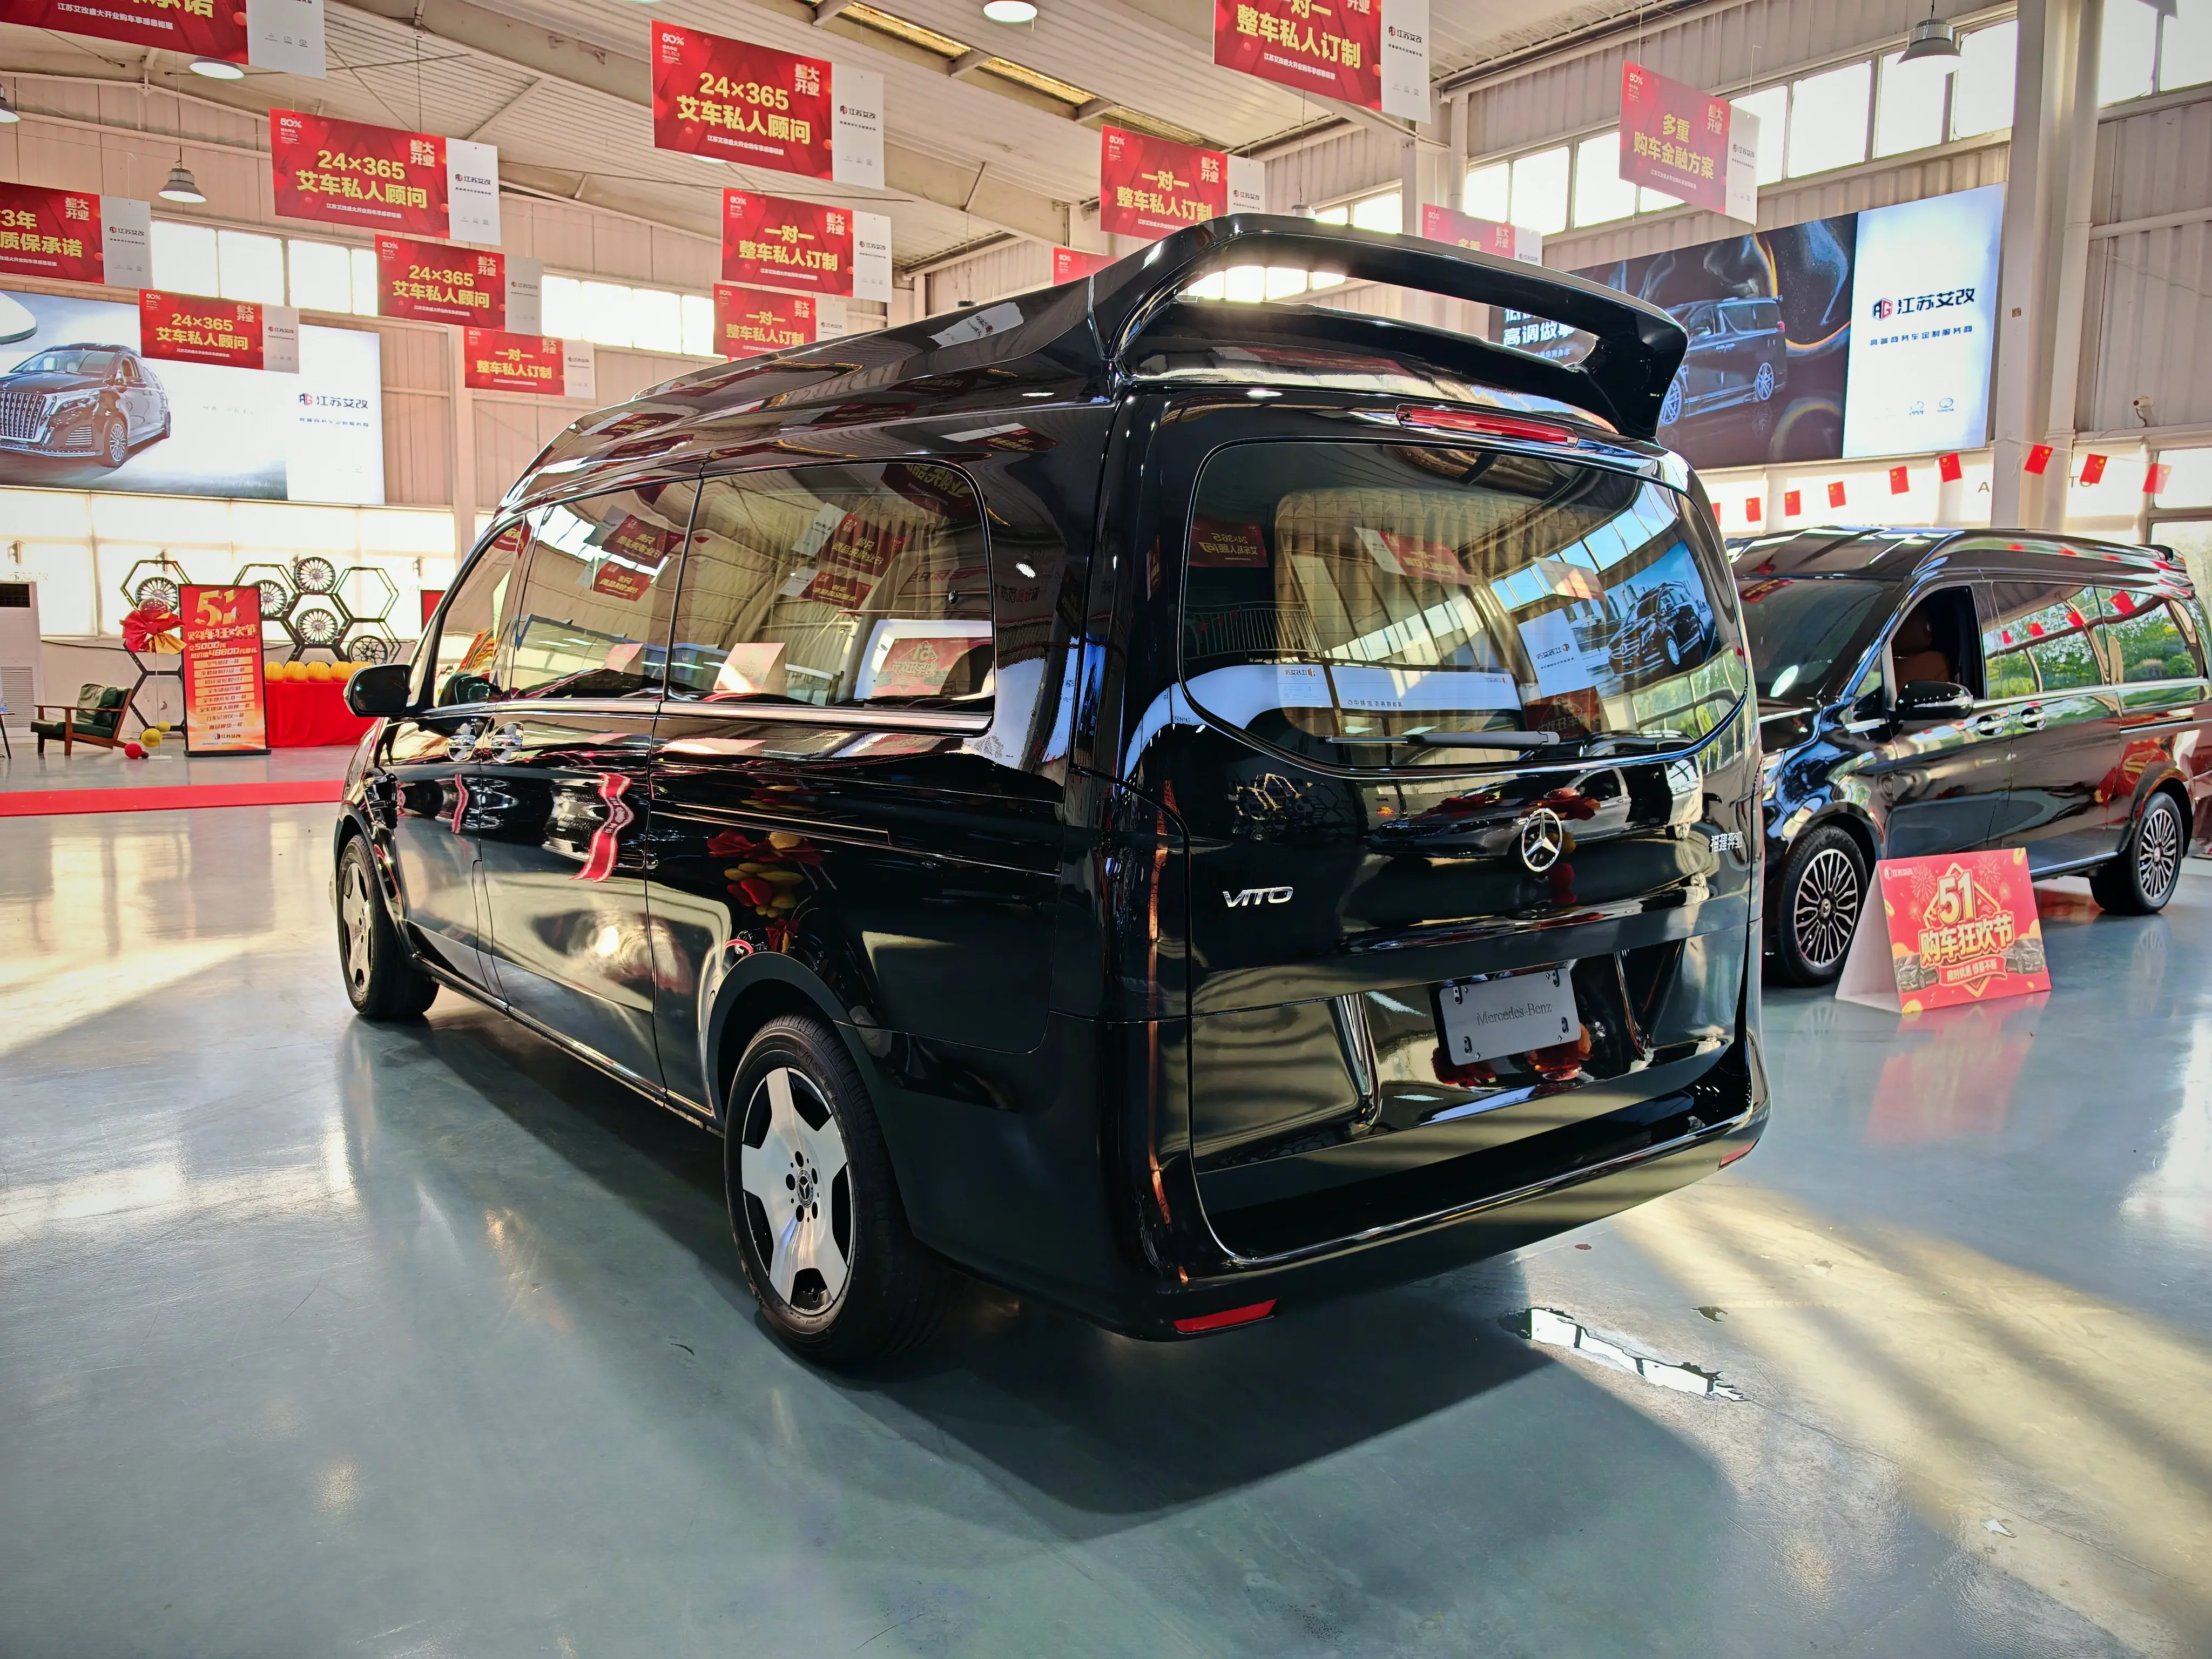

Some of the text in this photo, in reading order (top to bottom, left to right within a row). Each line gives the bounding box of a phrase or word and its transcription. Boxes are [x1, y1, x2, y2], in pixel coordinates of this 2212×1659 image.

[1284, 0, 1332, 18] 对一
[662, 32, 685, 46] 50%
[1236, 4, 1361, 69] 整车私人订制
[795, 64, 820, 82] 盛大
[1629, 73, 1643, 85] 50%
[795, 79, 820, 97] 开业
[280, 117, 302, 129] 50%
[676, 95, 811, 144] 艾车私人顾问
[1662, 113, 1690, 143] 多重
[410, 139, 435, 156] 盛大
[1109, 135, 1125, 146] 50%
[410, 152, 435, 167] 开业
[1202, 156, 1219, 172] 盛大
[1633, 131, 1715, 179] 购车金融方案
[1141, 170, 1190, 192] 一对一
[1201, 168, 1219, 183] 开业
[295, 170, 427, 208] 艾车私人顾问
[65, 197, 89, 211] 盛大
[730, 195, 747, 205] 50%
[1116, 186, 1212, 220] 整车私人订制
[0, 208, 37, 230] 3年
[65, 209, 90, 221] 开业
[826, 212, 845, 225] 盛大
[764, 225, 815, 243] 一对一
[826, 223, 845, 236] 开业
[0, 230, 83, 258] 质保承诺
[382, 241, 399, 249] 50%
[477, 255, 496, 268] 盛大
[738, 240, 838, 271] 整车私人订制
[477, 265, 496, 276] 开业
[392, 280, 490, 308] 艾车私人顾问
[1897, 288, 1975, 315] 江苏艾改
[237, 305, 254, 315] 盛大
[237, 313, 254, 323] 开业
[746, 311, 786, 326] 一对一
[156, 326, 248, 350] 艾车私人顾问
[725, 323, 804, 346] 整车私人订制
[495, 348, 534, 361] 一对一
[476, 359, 552, 379] 整车私人订制
[316, 395, 368, 409] 江苏艾改
[194, 589, 238, 626] 51
[1222, 886, 1293, 907] VITO
[1939, 872, 1975, 925] 51
[1920, 915, 2014, 965] 购车狂欢节
[1476, 1002, 1553, 1026] Mercedes-Benz
